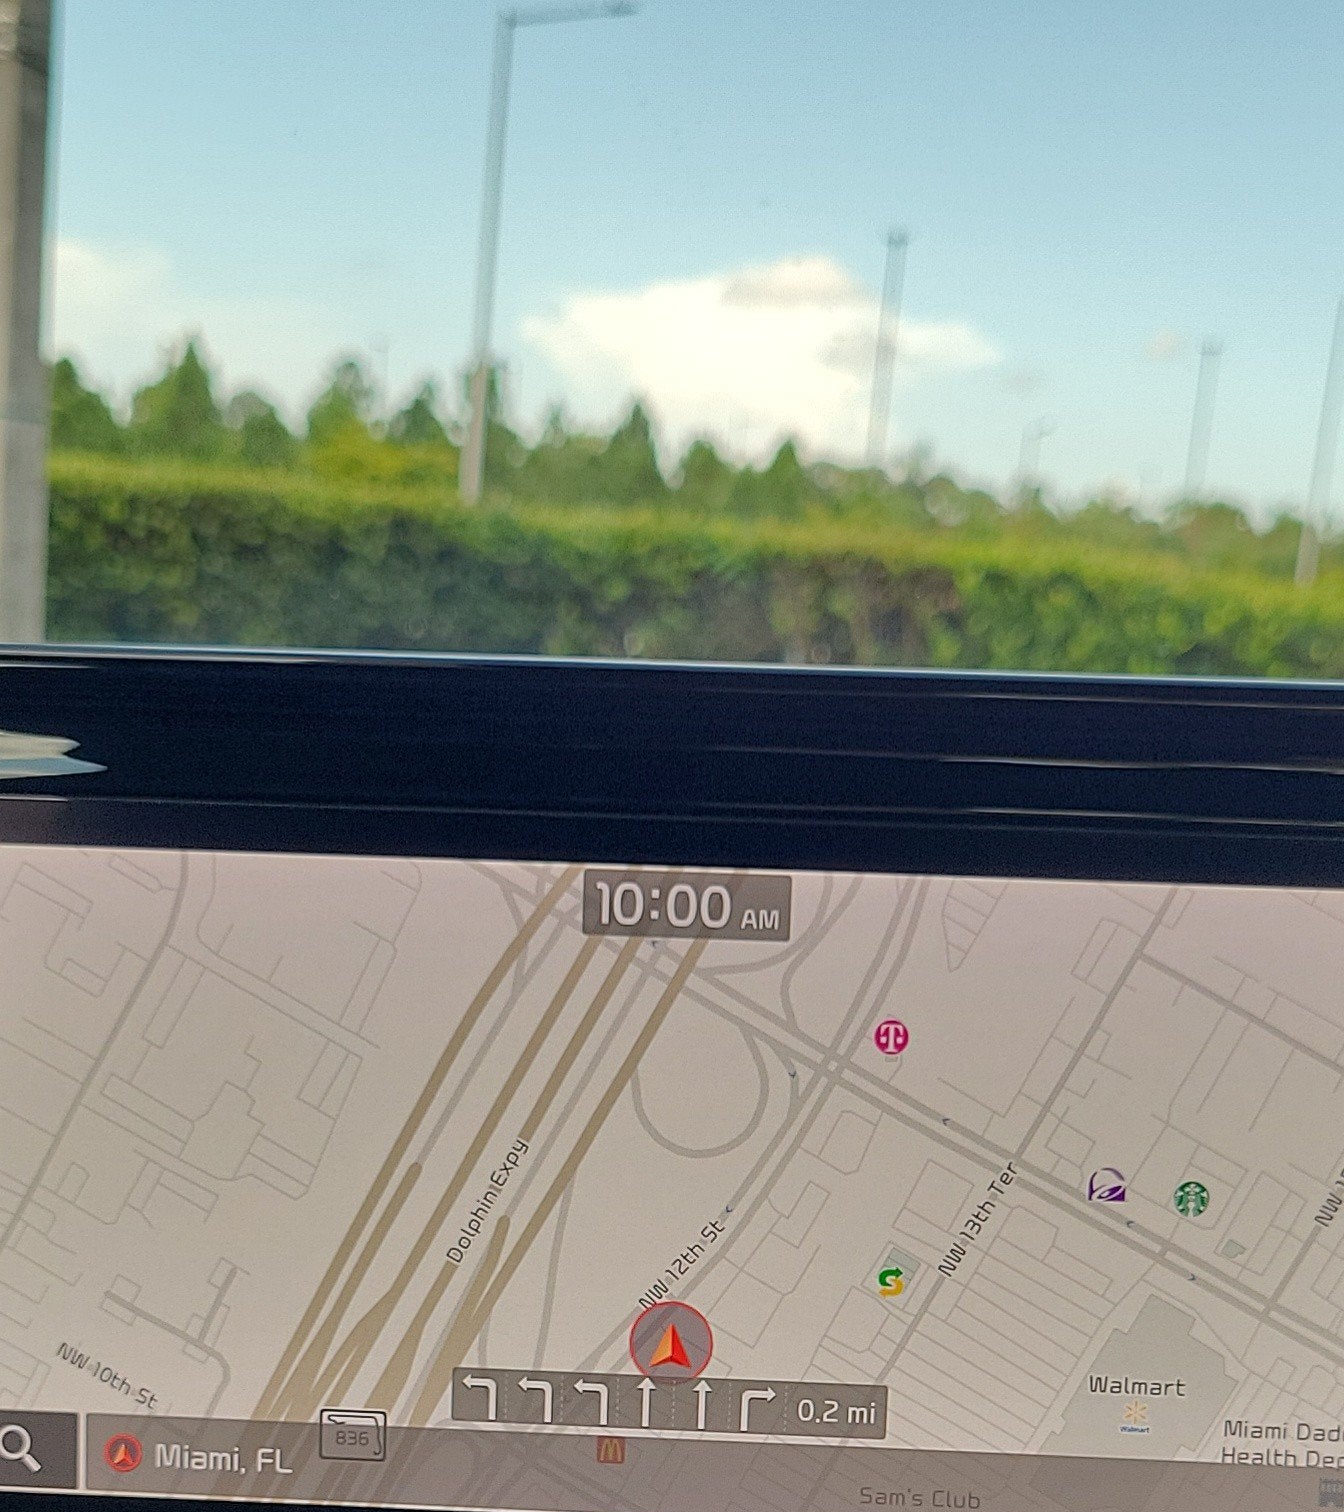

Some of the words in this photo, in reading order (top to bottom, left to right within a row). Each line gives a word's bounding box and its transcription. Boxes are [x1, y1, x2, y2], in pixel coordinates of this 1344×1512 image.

[595, 880, 732, 929] 10:00
[740, 908, 780, 931] AM
[446, 1188, 498, 1266] Dolphin
[490, 1138, 530, 1190] Expy
[939, 1240, 968, 1279] NW
[960, 1197, 996, 1248] 13th
[988, 1161, 1018, 1197] Ter
[638, 1278, 670, 1312] NW
[665, 1237, 707, 1281] 12th
[702, 1219, 726, 1245] St
[56, 1342, 92, 1370] NW
[92, 1361, 132, 1397] 10th
[134, 1387, 160, 1411] St
[1088, 1374, 1187, 1398] Walmart
[797, 1399, 839, 1424] 0.2
[846, 1401, 877, 1425] mi
[1222, 1419, 1288, 1442] Miami
[156, 1443, 246, 1476] Miami,
[256, 1447, 294, 1475] FL
[1221, 1445, 1298, 1469] Health
[859, 1486, 924, 1509] Sam's
[931, 1488, 981, 1511] Club
